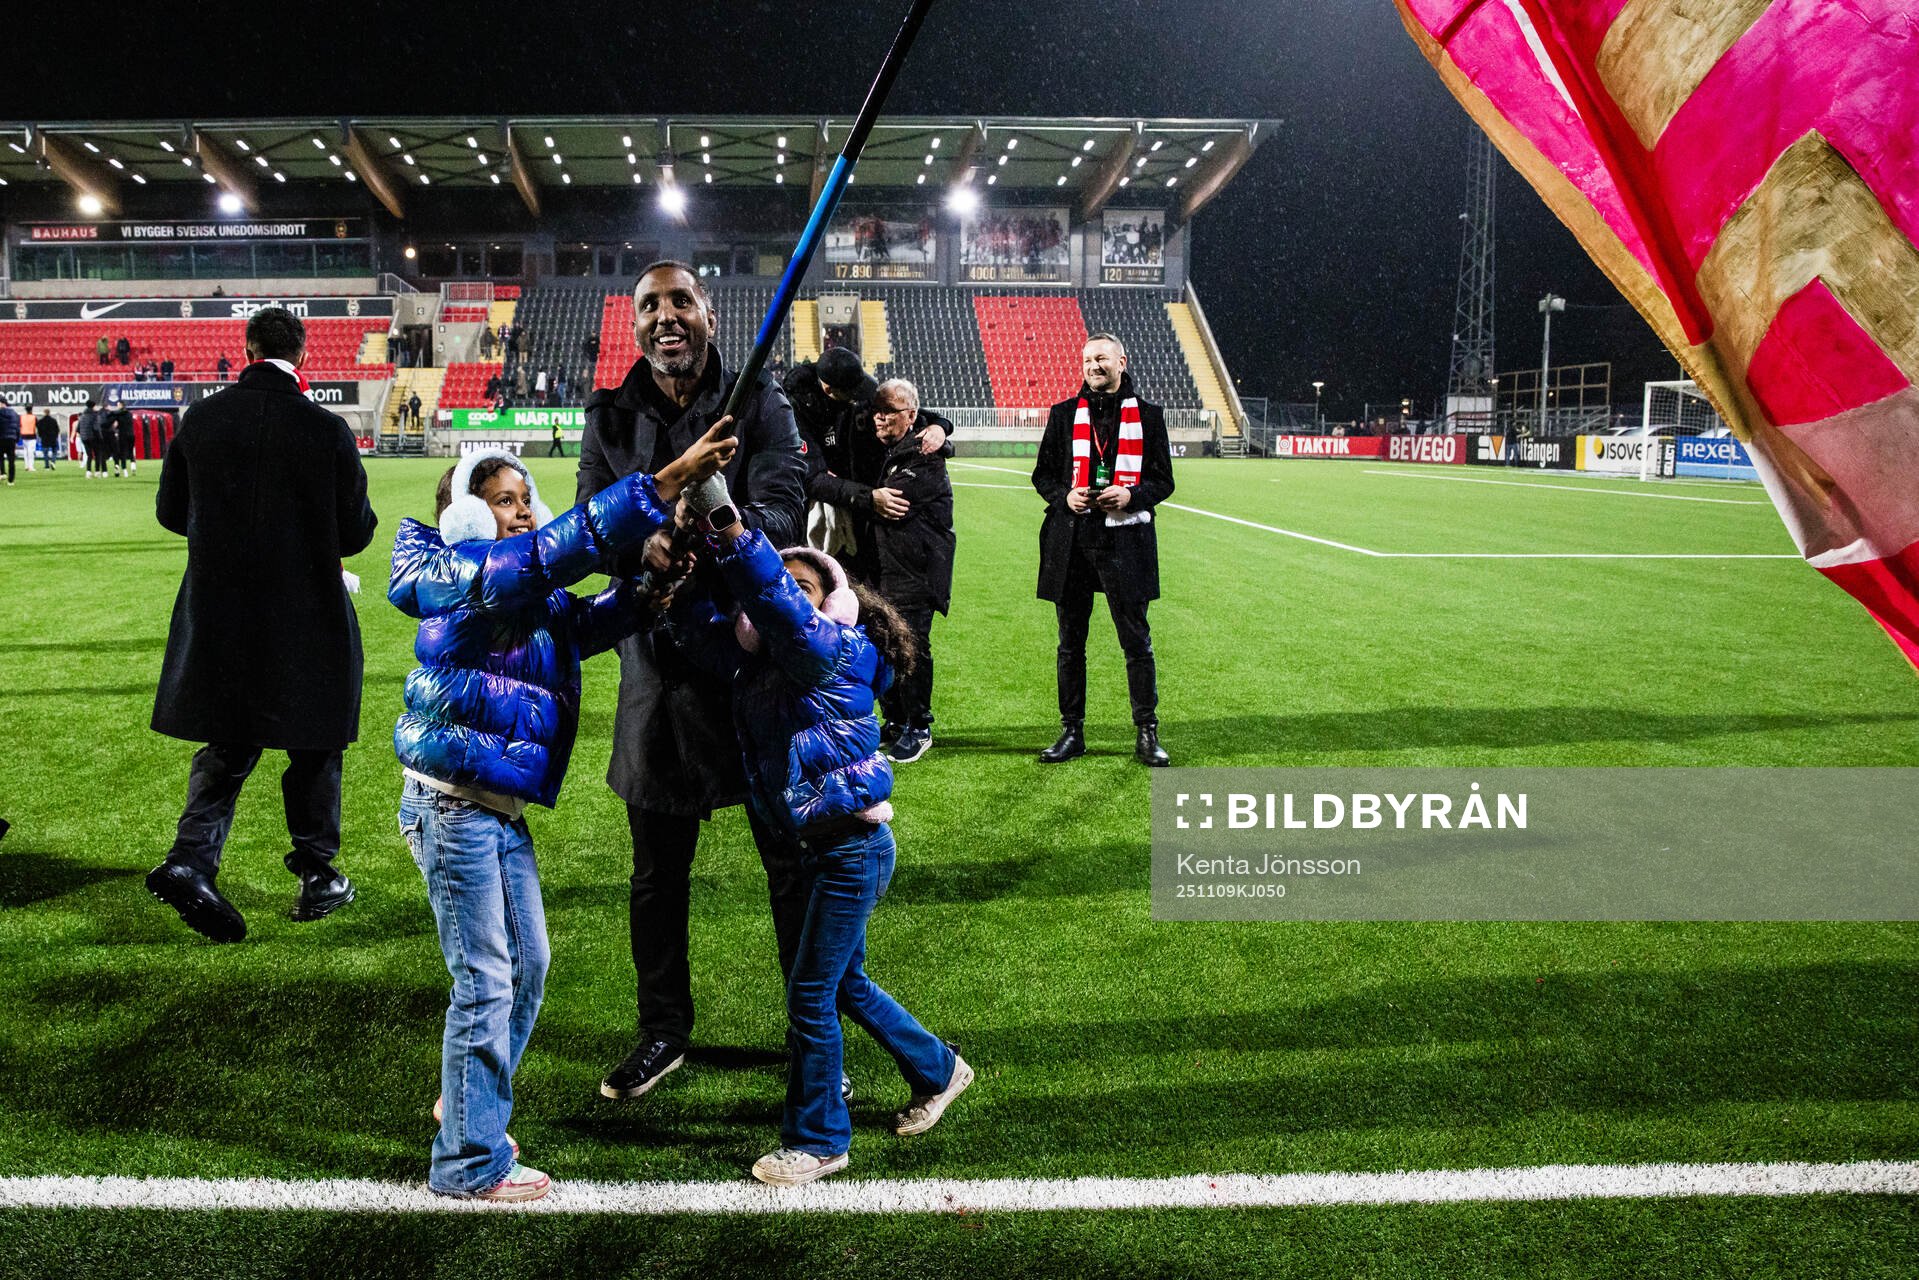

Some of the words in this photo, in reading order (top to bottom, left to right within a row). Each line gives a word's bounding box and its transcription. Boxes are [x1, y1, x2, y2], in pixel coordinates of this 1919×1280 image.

[33, 226, 98, 238] BAUHAUS
[121, 226, 132, 238] VI
[134, 226, 174, 237] BYGGER
[176, 225, 217, 237] SVENSK
[219, 224, 306, 236] UNGDOMSIDROTT
[969, 266, 996, 280] 4000
[1104, 269, 1122, 281] 120
[48, 386, 90, 404] NÖJD
[121, 389, 172, 401] ALLSVENSKAN
[313, 388, 343, 402] om
[824, 435, 836, 446] SH
[1295, 437, 1350, 455] TAKTIK
[1389, 436, 1456, 463] BEVEGO
